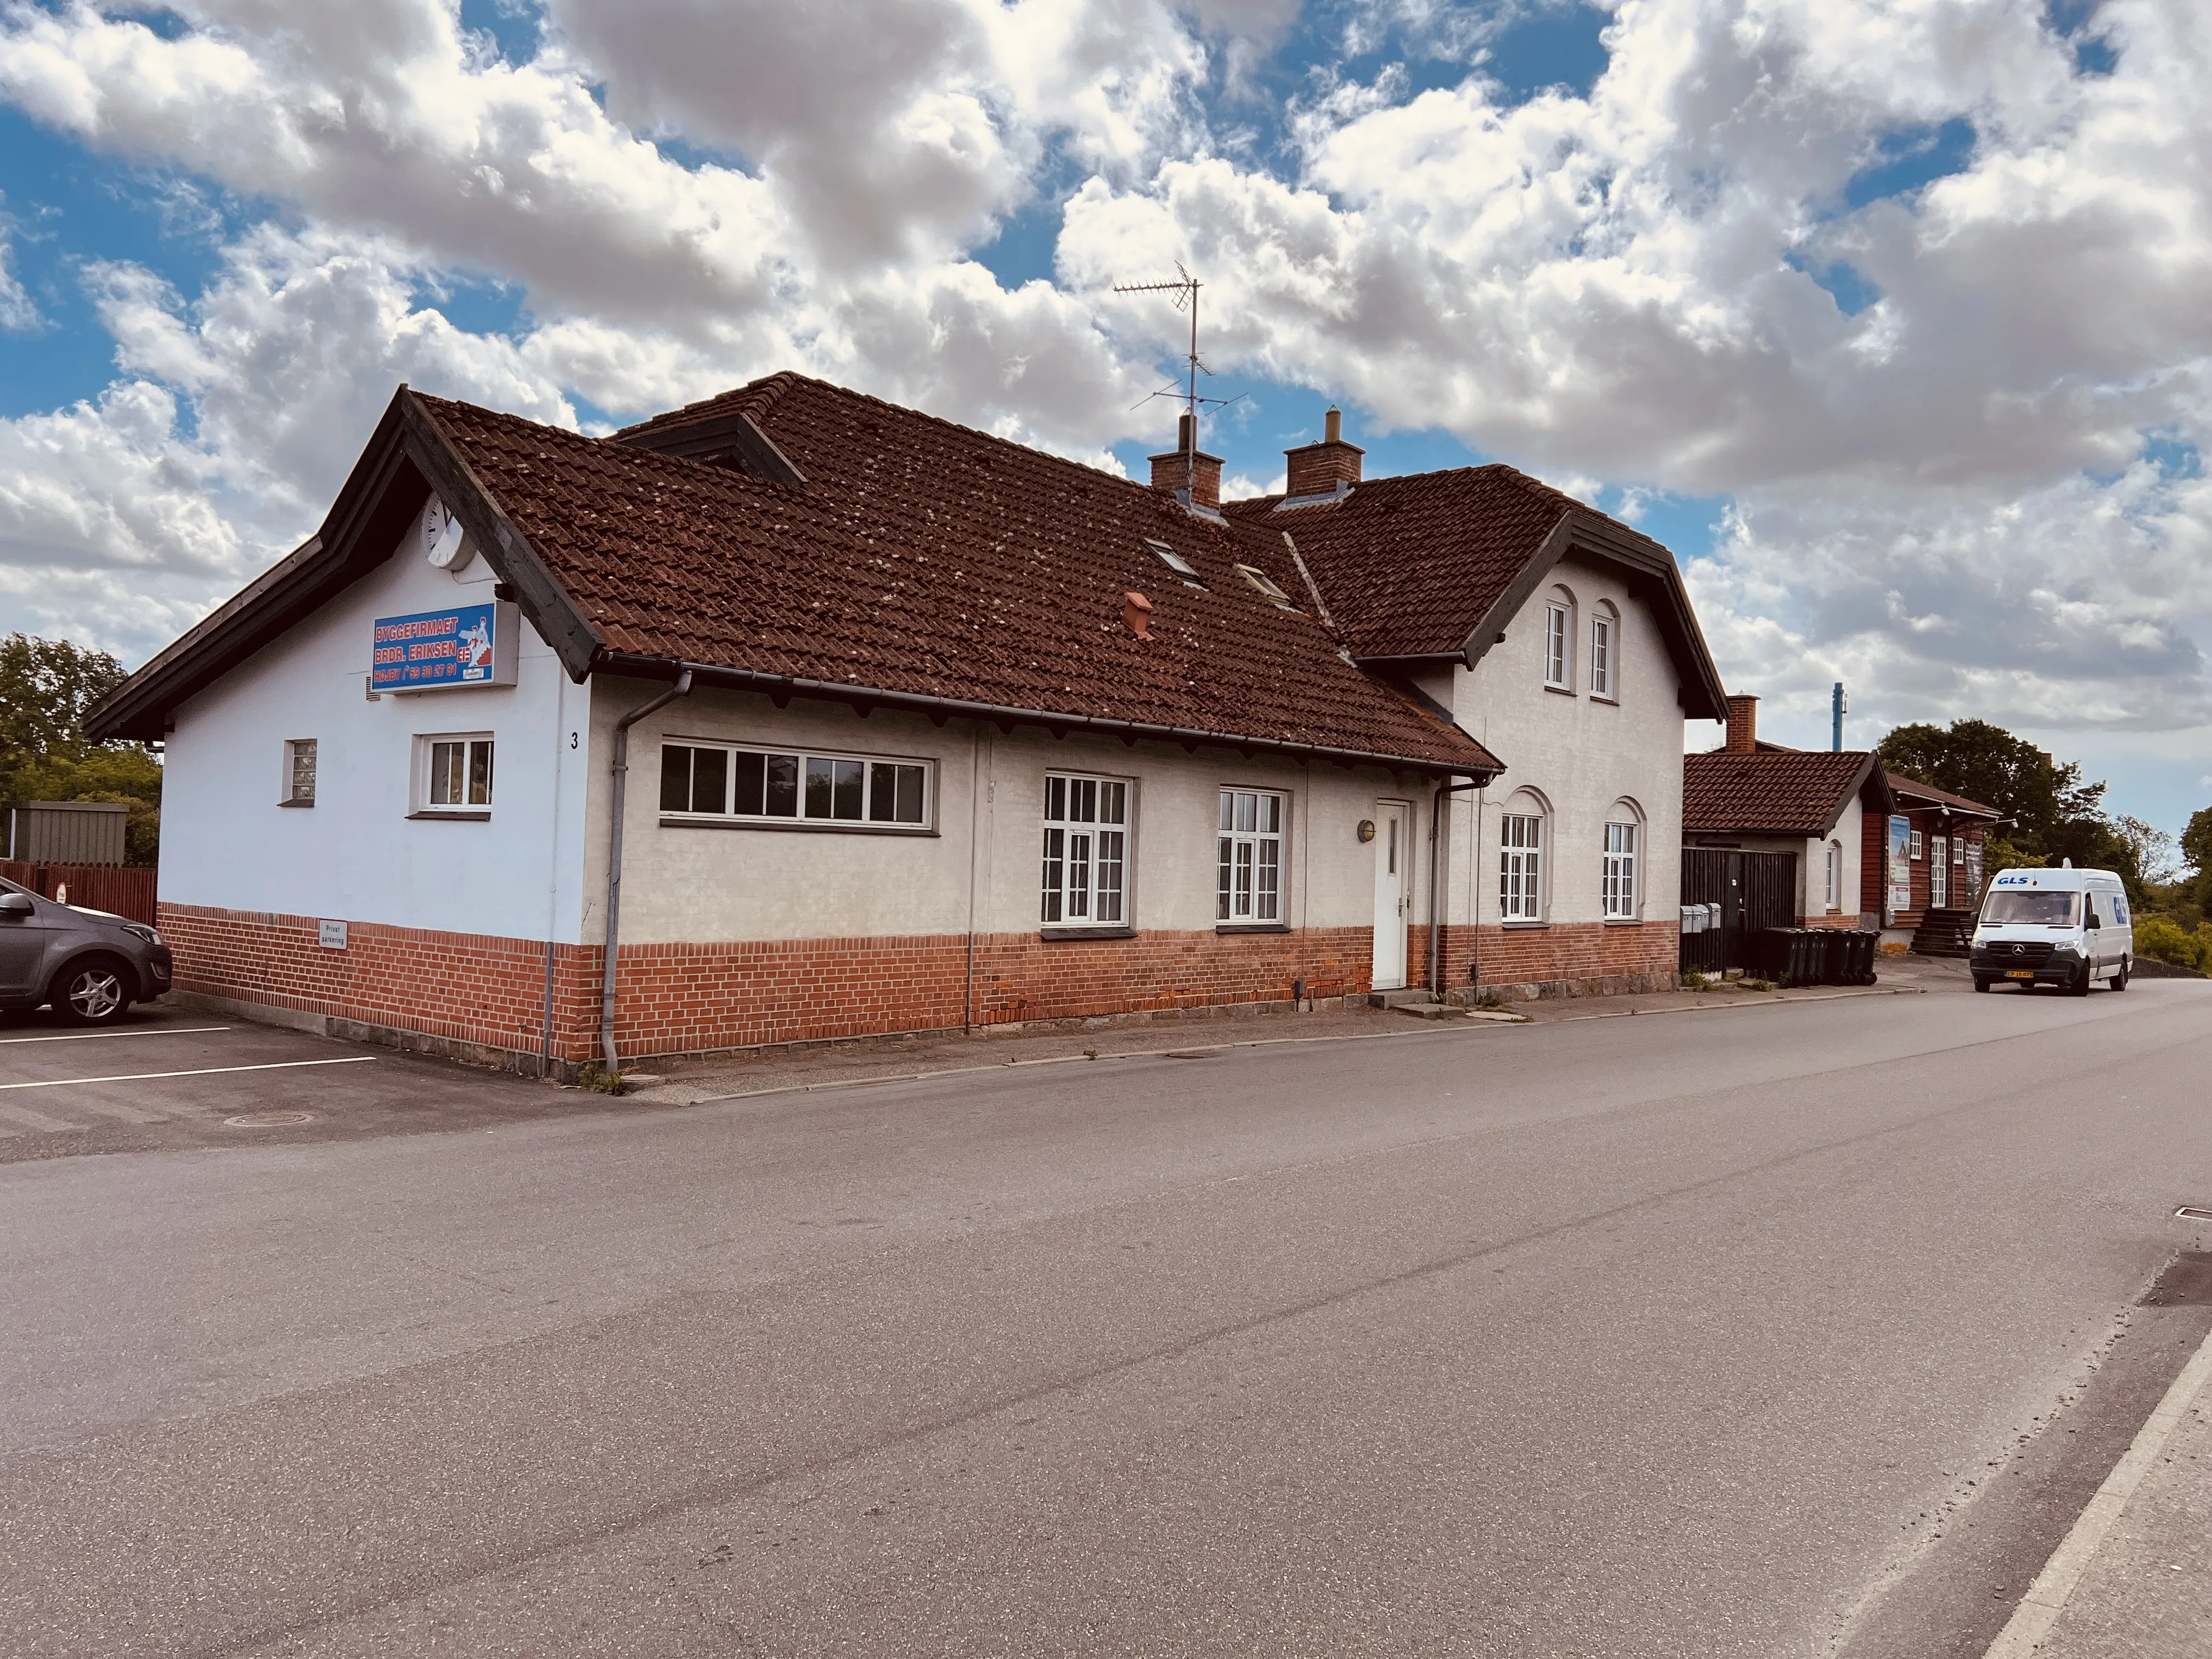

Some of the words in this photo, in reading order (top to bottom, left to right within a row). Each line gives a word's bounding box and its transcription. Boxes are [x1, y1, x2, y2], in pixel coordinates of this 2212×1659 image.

[375, 617, 458, 642] BYGGEFIRMAET
[374, 646, 406, 664] BRDR.
[409, 640, 456, 661] ERIKSEN
[409, 667, 420, 679] 59
[434, 664, 445, 677] 27
[447, 663, 456, 676] 81
[571, 732, 578, 749] 3
[321, 936, 344, 945] parkering
